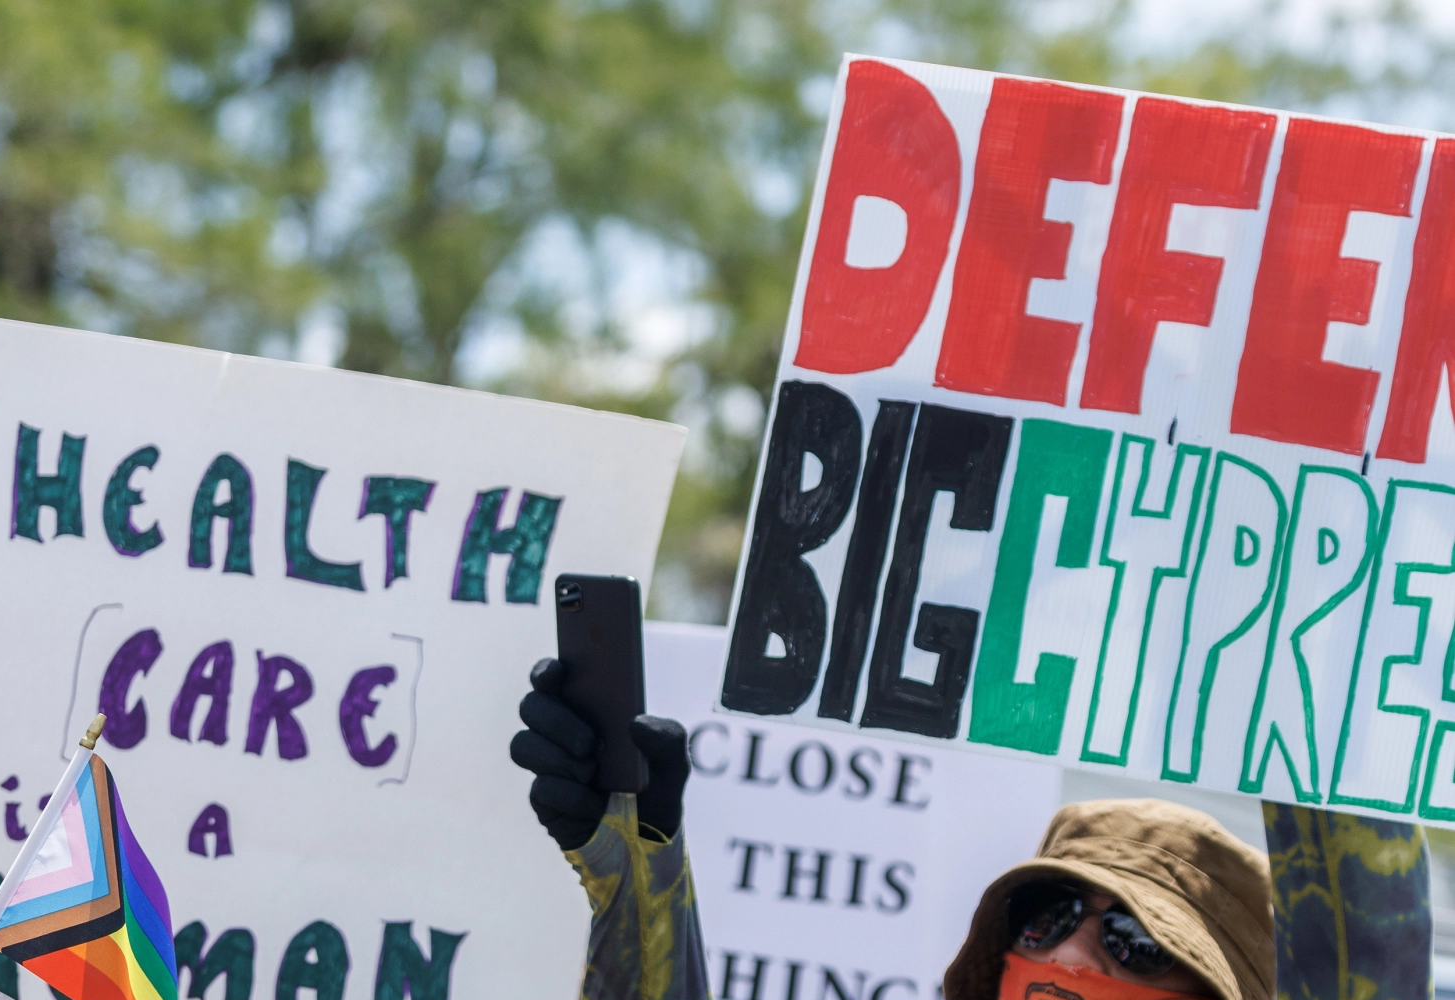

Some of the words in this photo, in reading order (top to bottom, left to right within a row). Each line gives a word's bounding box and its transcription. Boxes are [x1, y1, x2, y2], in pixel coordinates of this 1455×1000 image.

[9, 421, 565, 605] HEALTH
[720, 380, 1015, 739] BIG
[968, 417, 1455, 823] CYPRE
[688, 720, 933, 812] CLOSE
[188, 803, 234, 859] A
[728, 835, 916, 915] THIS
